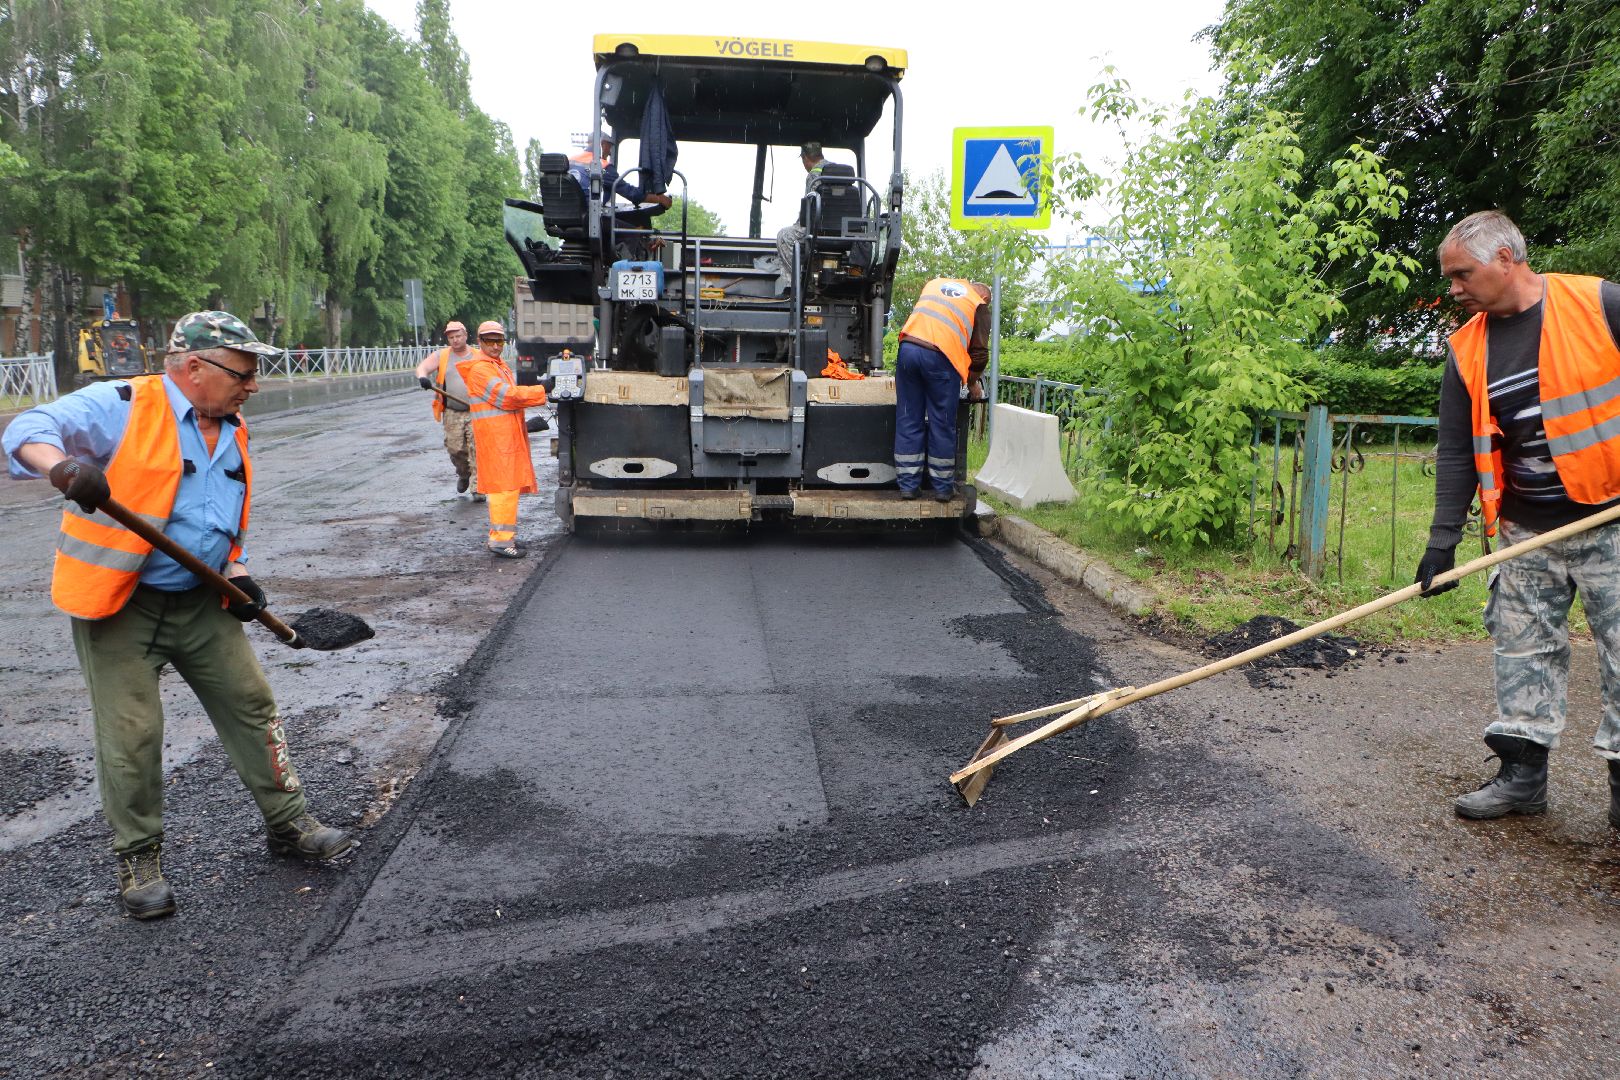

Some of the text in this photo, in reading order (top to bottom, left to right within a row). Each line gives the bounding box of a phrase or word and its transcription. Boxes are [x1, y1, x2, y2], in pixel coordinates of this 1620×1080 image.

[715, 36, 794, 57] VÖGELE
[623, 274, 652, 285] 2713
[642, 289, 654, 298] 50
